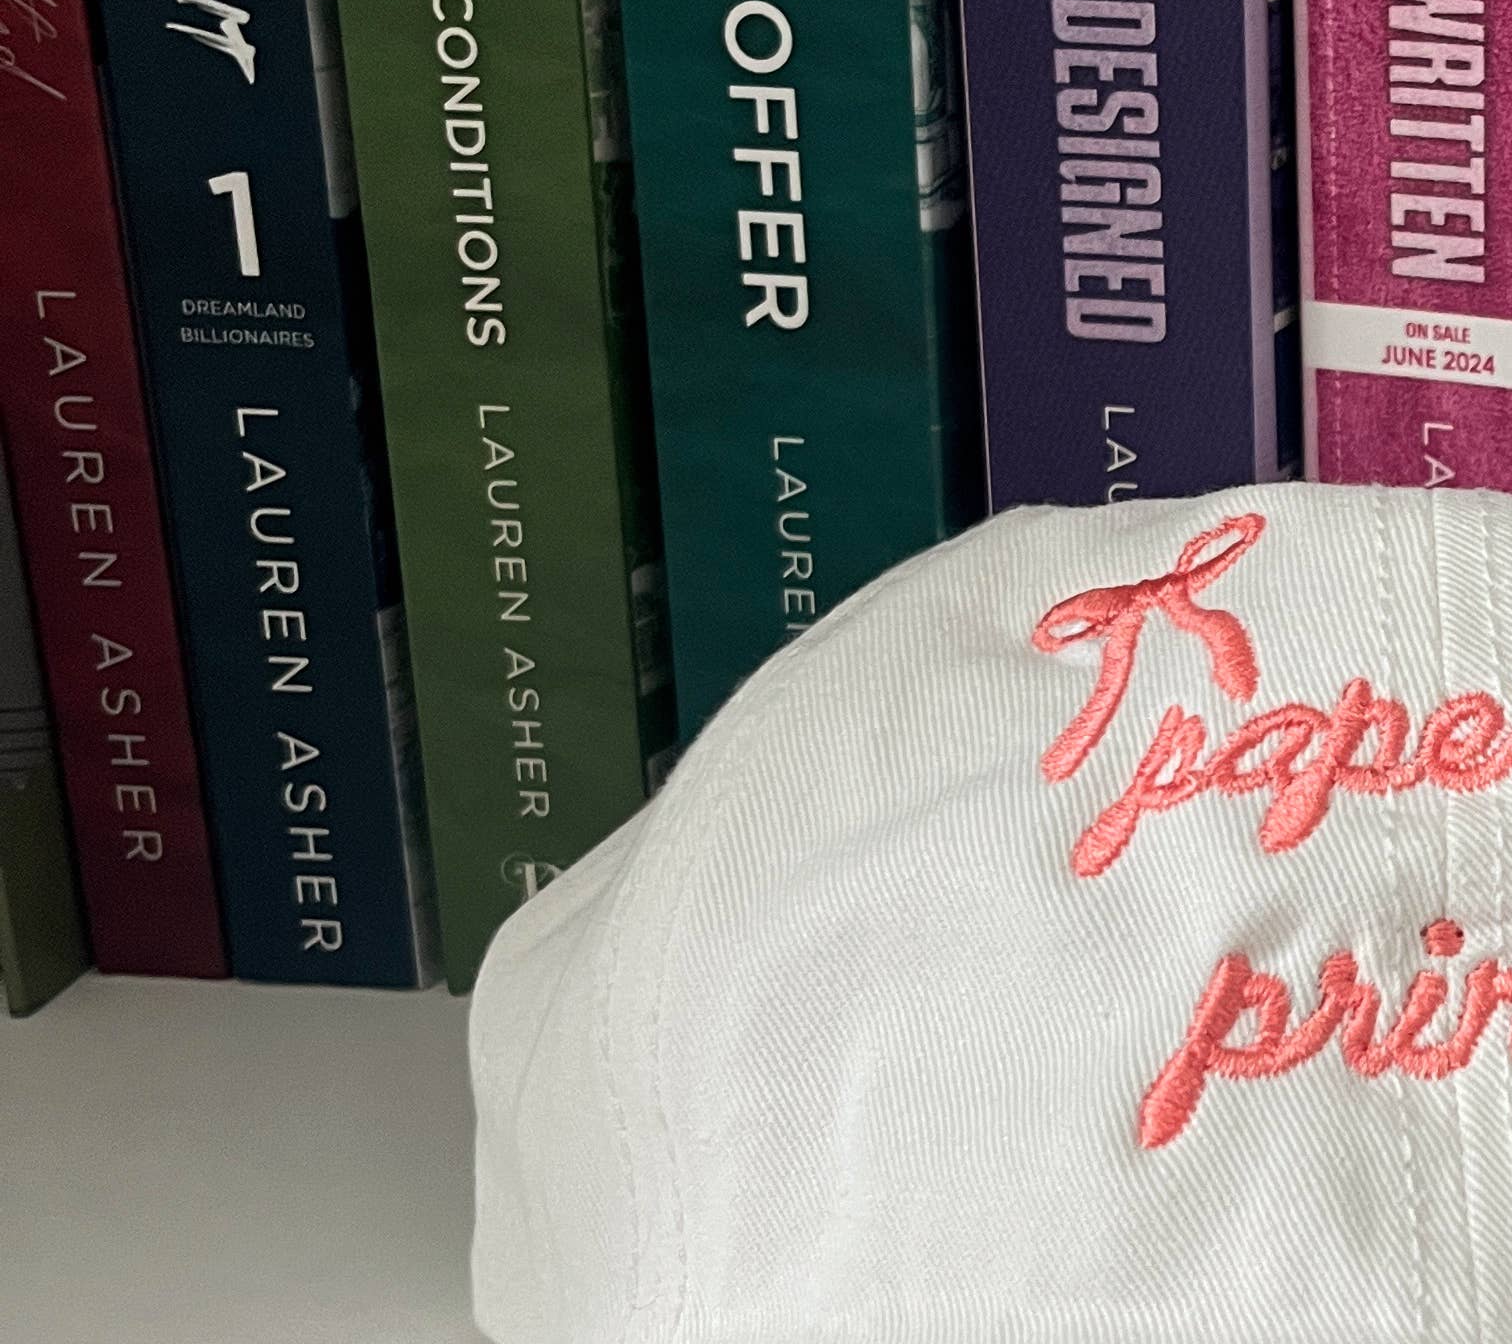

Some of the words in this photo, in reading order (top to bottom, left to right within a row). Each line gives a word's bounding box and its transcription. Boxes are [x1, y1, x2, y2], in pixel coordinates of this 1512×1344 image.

[724, 0, 809, 330] OFFER
[209, 171, 261, 277] 1
[180, 326, 316, 350] BILLIONAIRES
[181, 298, 307, 322] DREAMLAND
[1381, 345, 1437, 370] JUNE
[1442, 351, 1495, 376] 2024
[1405, 321, 1427, 342] ON
[1432, 324, 1471, 345] SALE
[1423, 422, 1455, 488] LA
[478, 403, 531, 623] LAUREN
[35, 288, 123, 588] LAUREN
[91, 634, 163, 863] ASHER
[236, 406, 313, 695] LAUREN
[276, 732, 344, 955] ASHER
[503, 646, 550, 820] ASHER
